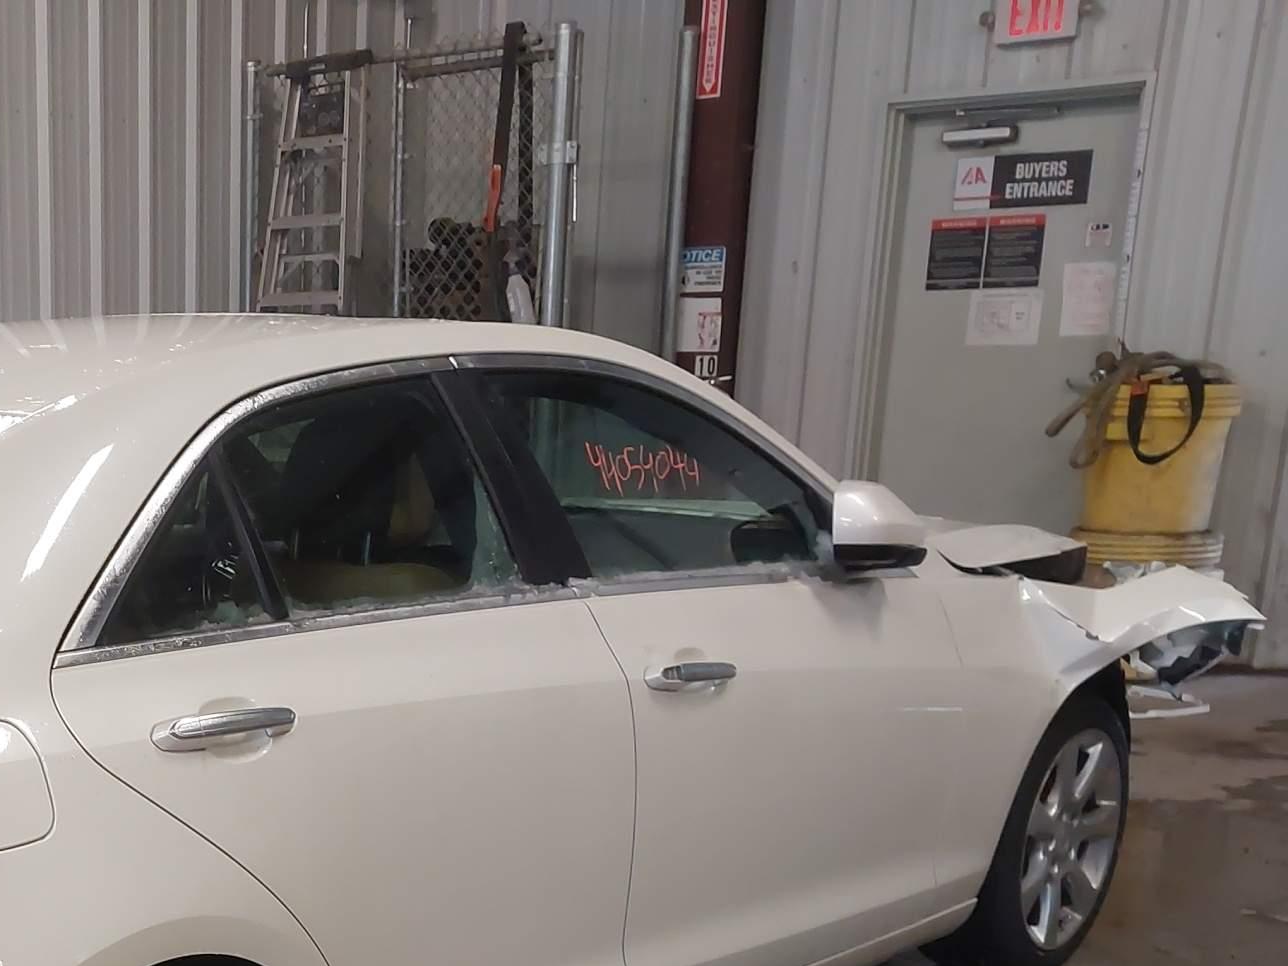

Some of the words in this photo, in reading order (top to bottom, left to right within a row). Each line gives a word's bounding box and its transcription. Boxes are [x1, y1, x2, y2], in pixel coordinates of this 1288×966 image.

[1015, 160, 1068, 179] BUYERS
[1005, 180, 1074, 199] ENTRANCE
[699, 356, 716, 376] 10
[584, 441, 700, 497] 44054044
